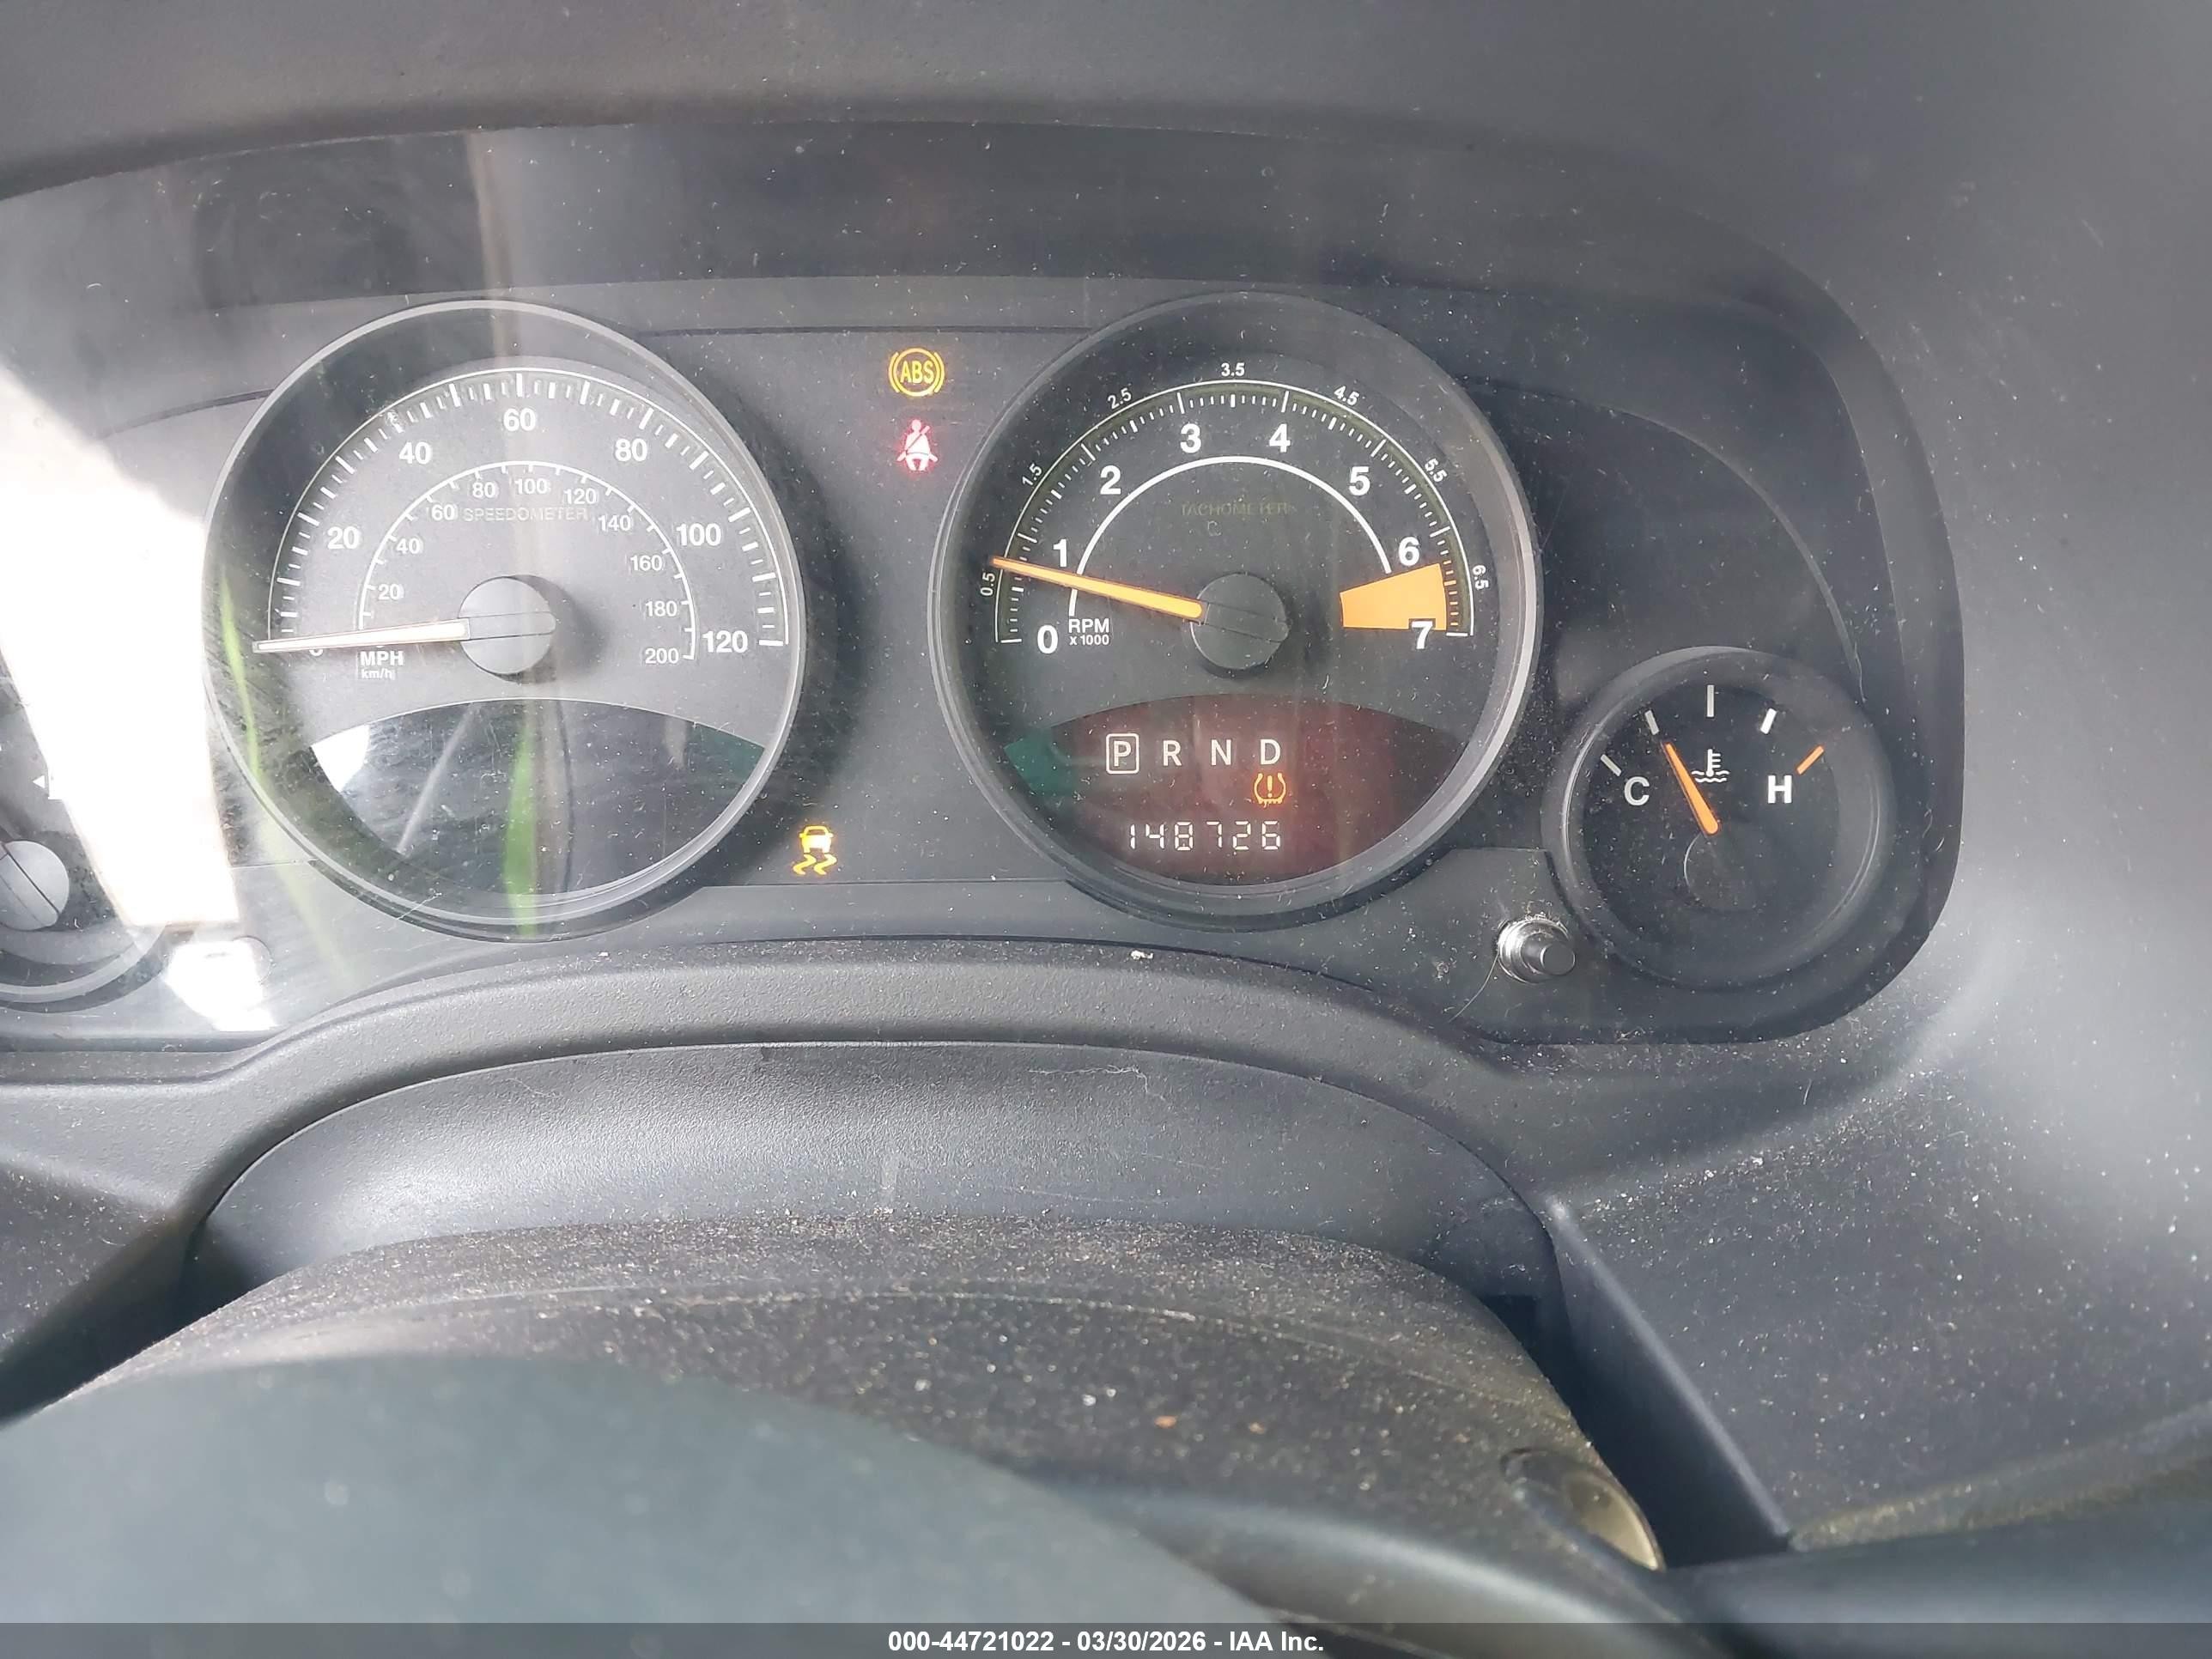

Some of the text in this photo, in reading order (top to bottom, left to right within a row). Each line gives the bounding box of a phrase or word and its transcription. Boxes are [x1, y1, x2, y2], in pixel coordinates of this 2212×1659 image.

[900, 361, 935, 384] ABS
[1221, 362, 1245, 376] 3.5
[1108, 387, 1132, 409] 2.5
[1334, 386, 1359, 406] 4.5
[503, 408, 537, 431] 60
[1180, 423, 1201, 453] 3
[1269, 423, 1291, 453] 4
[398, 441, 431, 465] 40
[615, 439, 647, 461] 80
[1021, 463, 1042, 486] 1.5
[1100, 465, 1121, 495] 2
[1349, 466, 1370, 495] 5
[1425, 458, 1447, 483] 5.5
[472, 482, 495, 498] 80
[515, 478, 548, 495] 100
[563, 488, 597, 504] 120
[431, 504, 455, 520] 60
[464, 507, 587, 521] SPEEDOMETER
[599, 515, 631, 531] 140
[327, 526, 359, 550] 20
[396, 538, 421, 554] 40
[677, 523, 721, 546] 100
[630, 555, 663, 571] 160
[1053, 539, 1067, 568] 1
[1398, 537, 1419, 566] 6
[980, 573, 995, 597] 0.5
[1472, 564, 1489, 590] 6.5
[378, 584, 401, 599] 20
[646, 601, 678, 617] 180
[1068, 618, 1109, 633] RPM
[1411, 621, 1433, 649] 7
[702, 630, 748, 653] 120
[1036, 624, 1059, 653] 0
[360, 651, 404, 665] MPH
[645, 648, 678, 664] 200
[362, 668, 392, 679] km/h
[1114, 739, 1280, 767] P R N D
[1624, 776, 1650, 805] C
[1768, 775, 1792, 804] H
[1129, 820, 1280, 851] 148726
